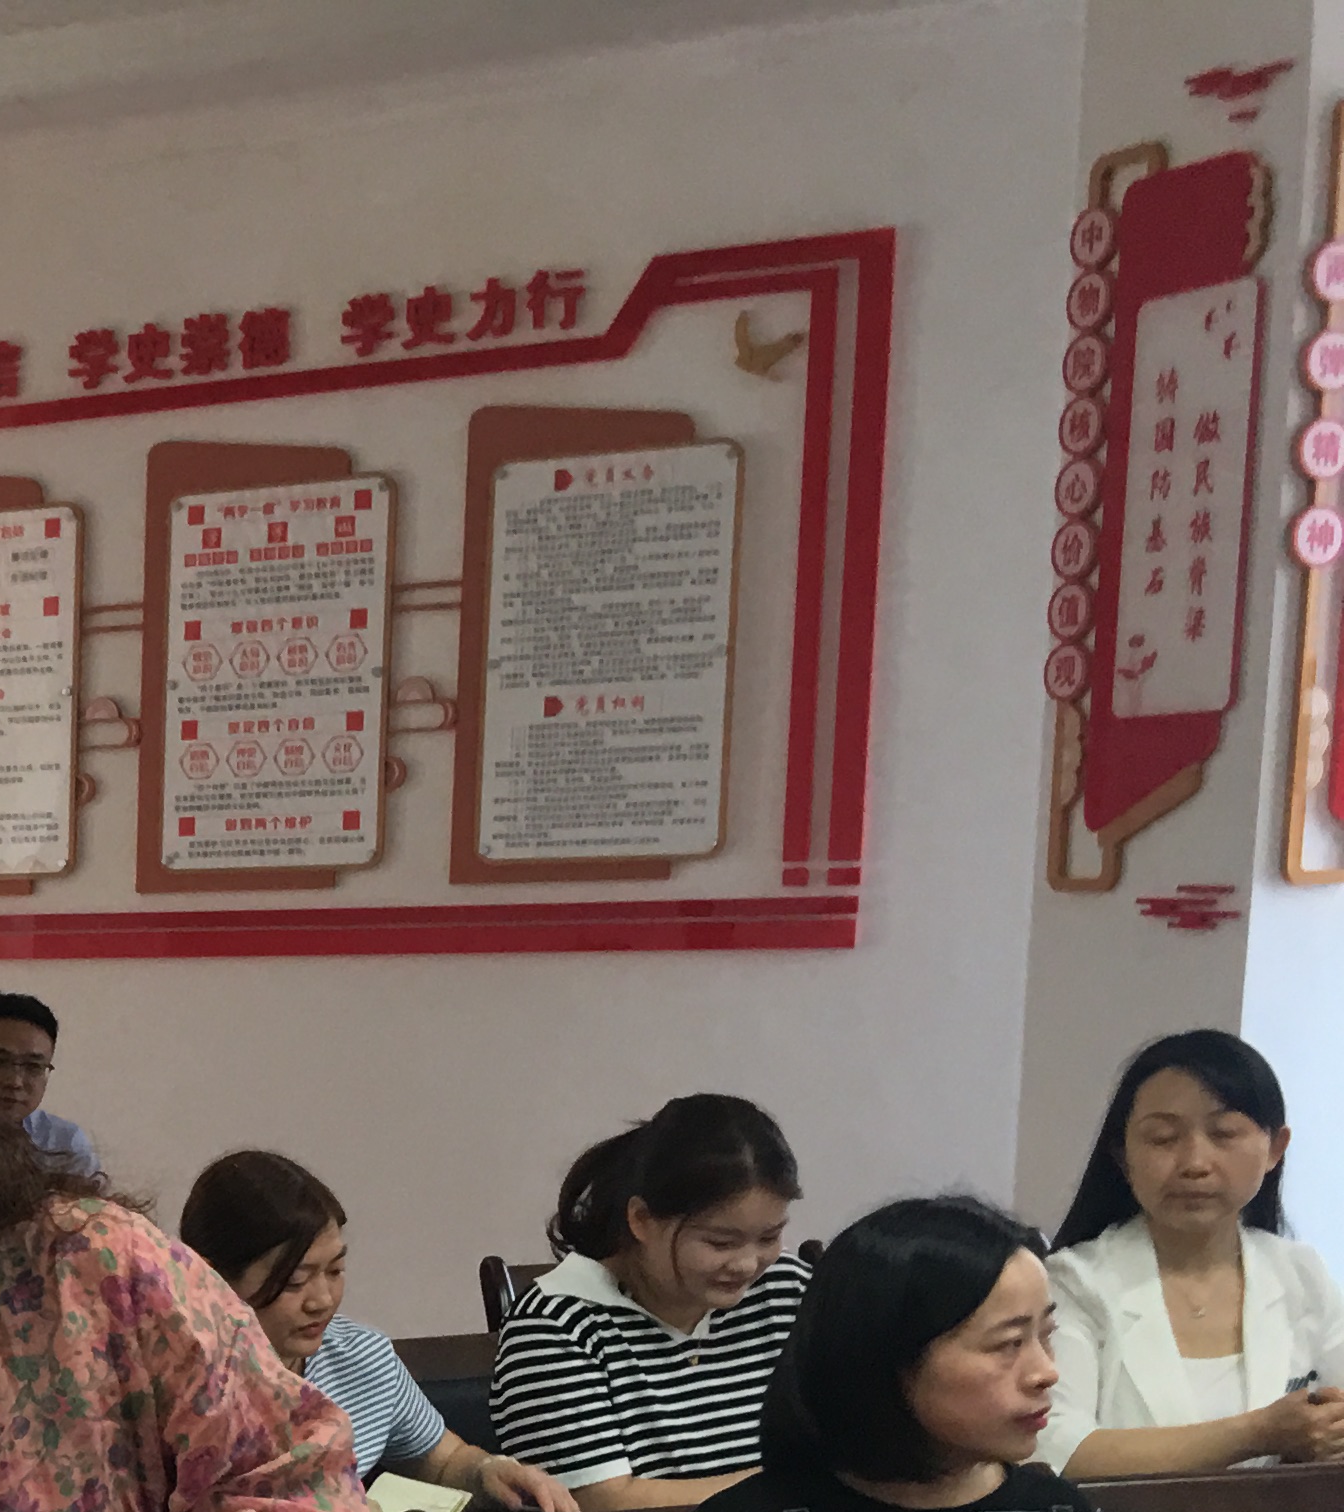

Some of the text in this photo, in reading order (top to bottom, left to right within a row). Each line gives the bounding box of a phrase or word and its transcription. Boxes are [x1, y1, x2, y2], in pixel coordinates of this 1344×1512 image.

[67, 307, 291, 390] 学史崇德
[339, 268, 586, 357] 学史力行
